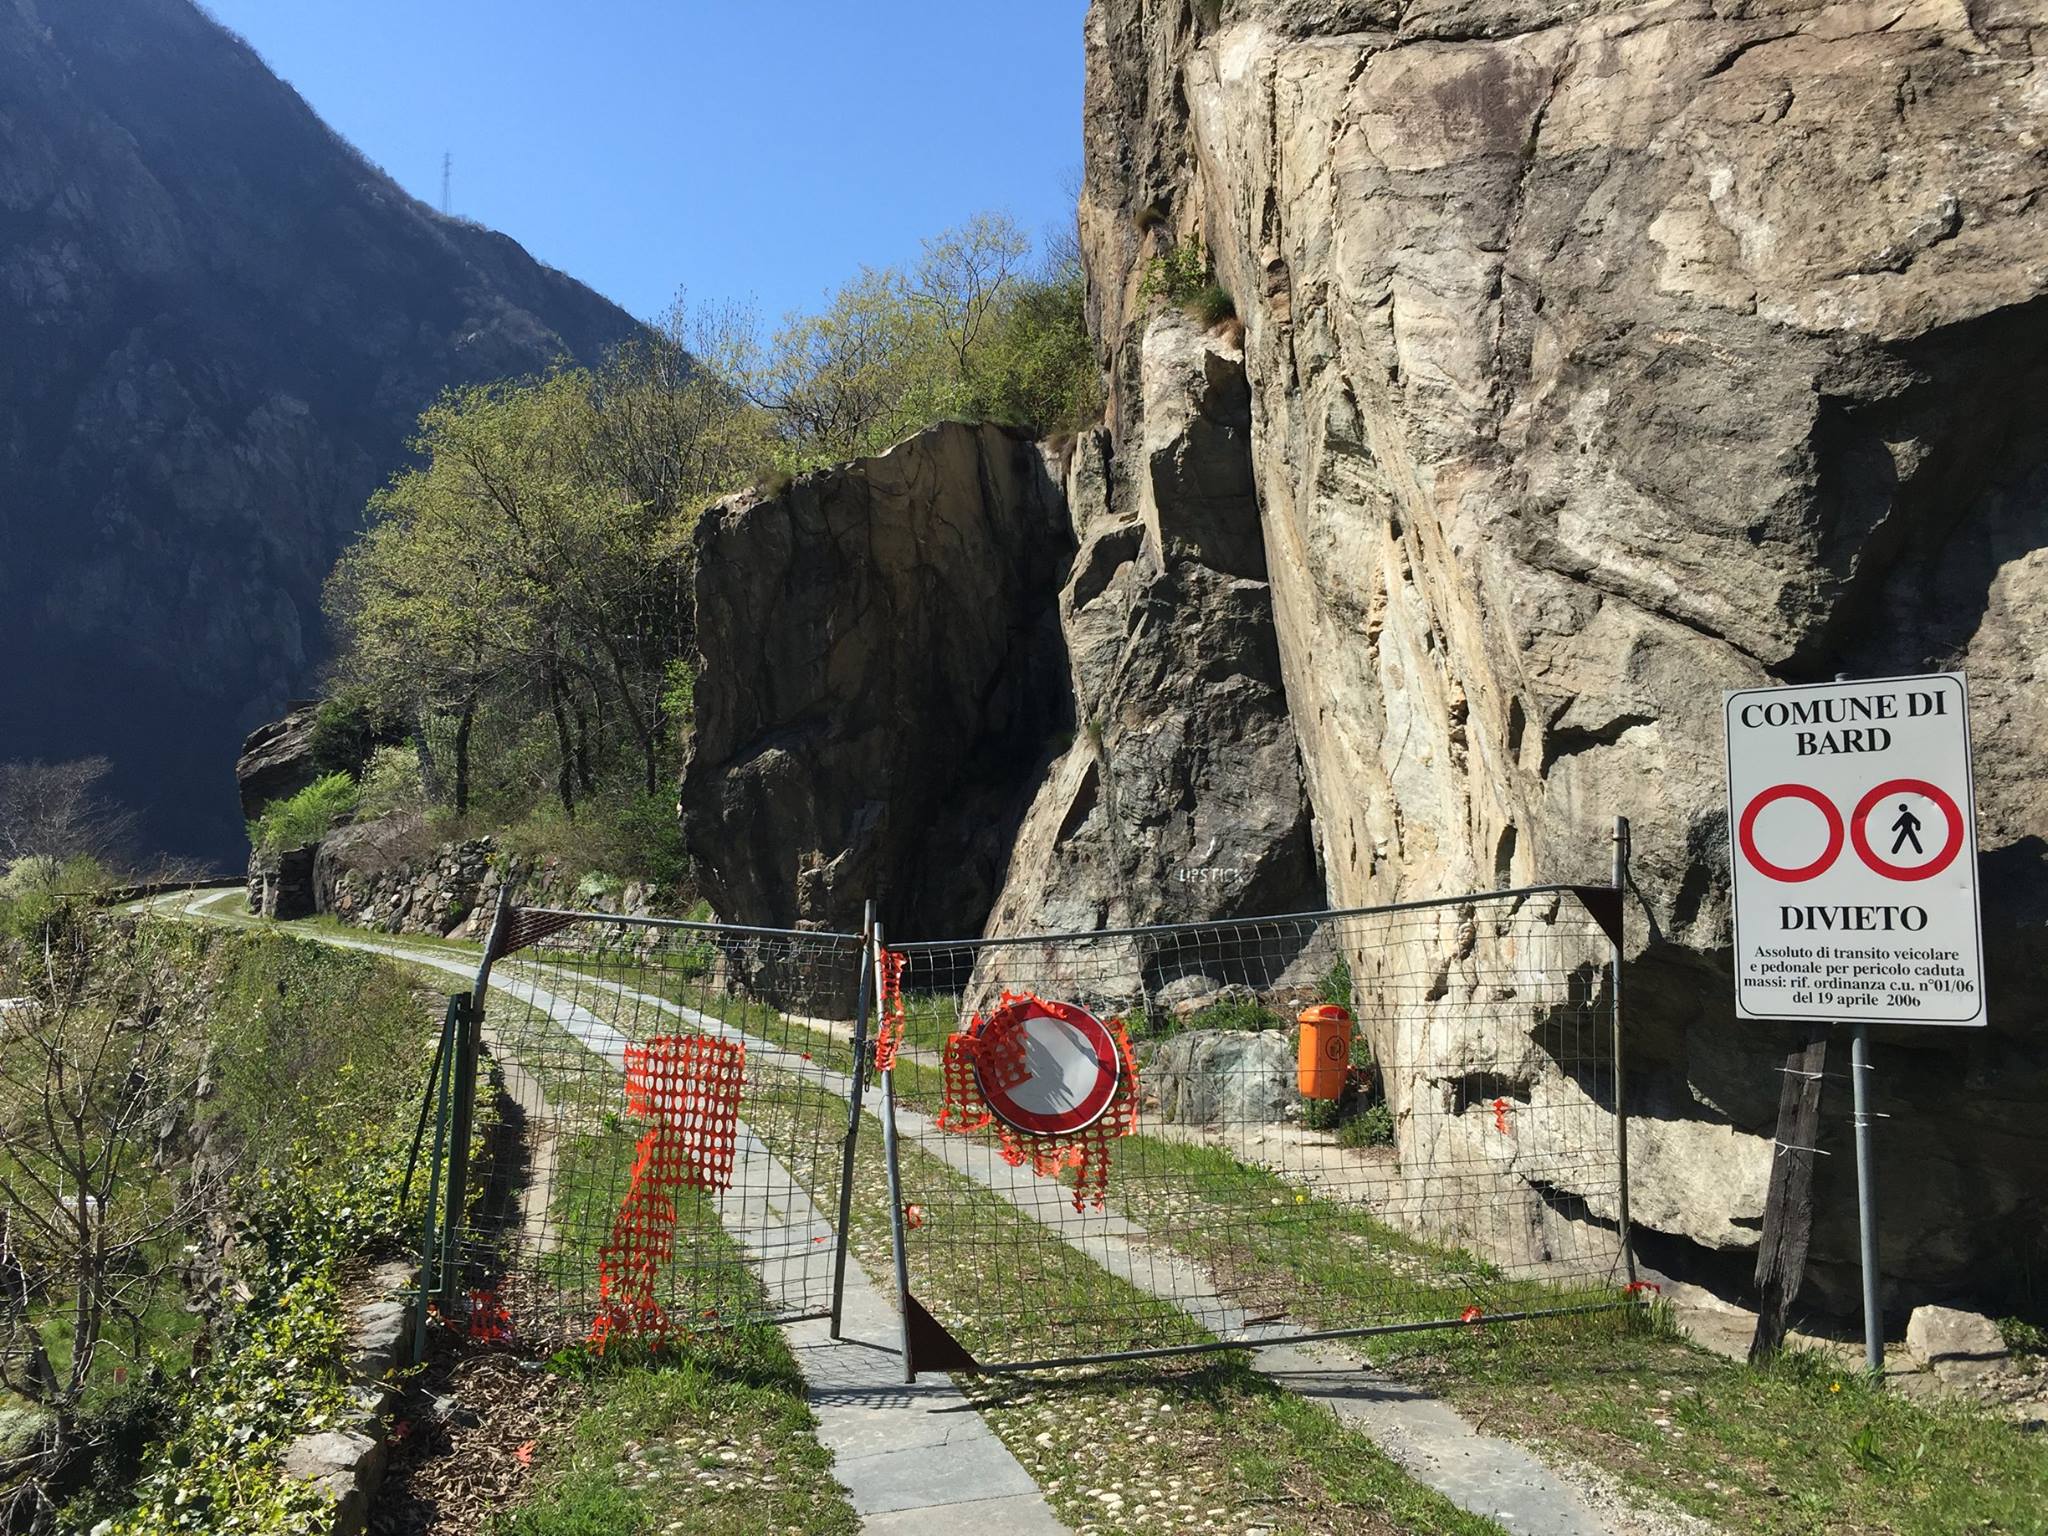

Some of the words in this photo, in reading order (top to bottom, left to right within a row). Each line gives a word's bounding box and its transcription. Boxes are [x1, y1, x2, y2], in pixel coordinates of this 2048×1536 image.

[1741, 694, 1898, 728] COMUNE
[1907, 690, 1948, 717] DI
[1795, 727, 1891, 756] BARD
[1780, 905, 1928, 931] DIVIETO
[1755, 946, 1813, 959] Assoluto
[1816, 947, 1829, 959] di
[1834, 947, 1890, 960] transito
[1893, 948, 1959, 961] veicolare
[1750, 963, 1757, 972] e
[1761, 962, 1822, 977] pedonale
[1826, 965, 1849, 977] per
[1853, 963, 1911, 978] pericolo
[1914, 964, 1965, 977] caduta
[1744, 976, 1787, 988] massi:
[1790, 976, 1810, 988] rif.
[1814, 977, 1886, 991] ordinanza
[1890, 981, 1915, 991] c.u.
[1919, 979, 1974, 993] n°01/06
[1793, 992, 1814, 1004] del
[1818, 992, 1833, 1004] 19
[1837, 993, 1879, 1007] aprile
[1886, 995, 1921, 1007] 2006
